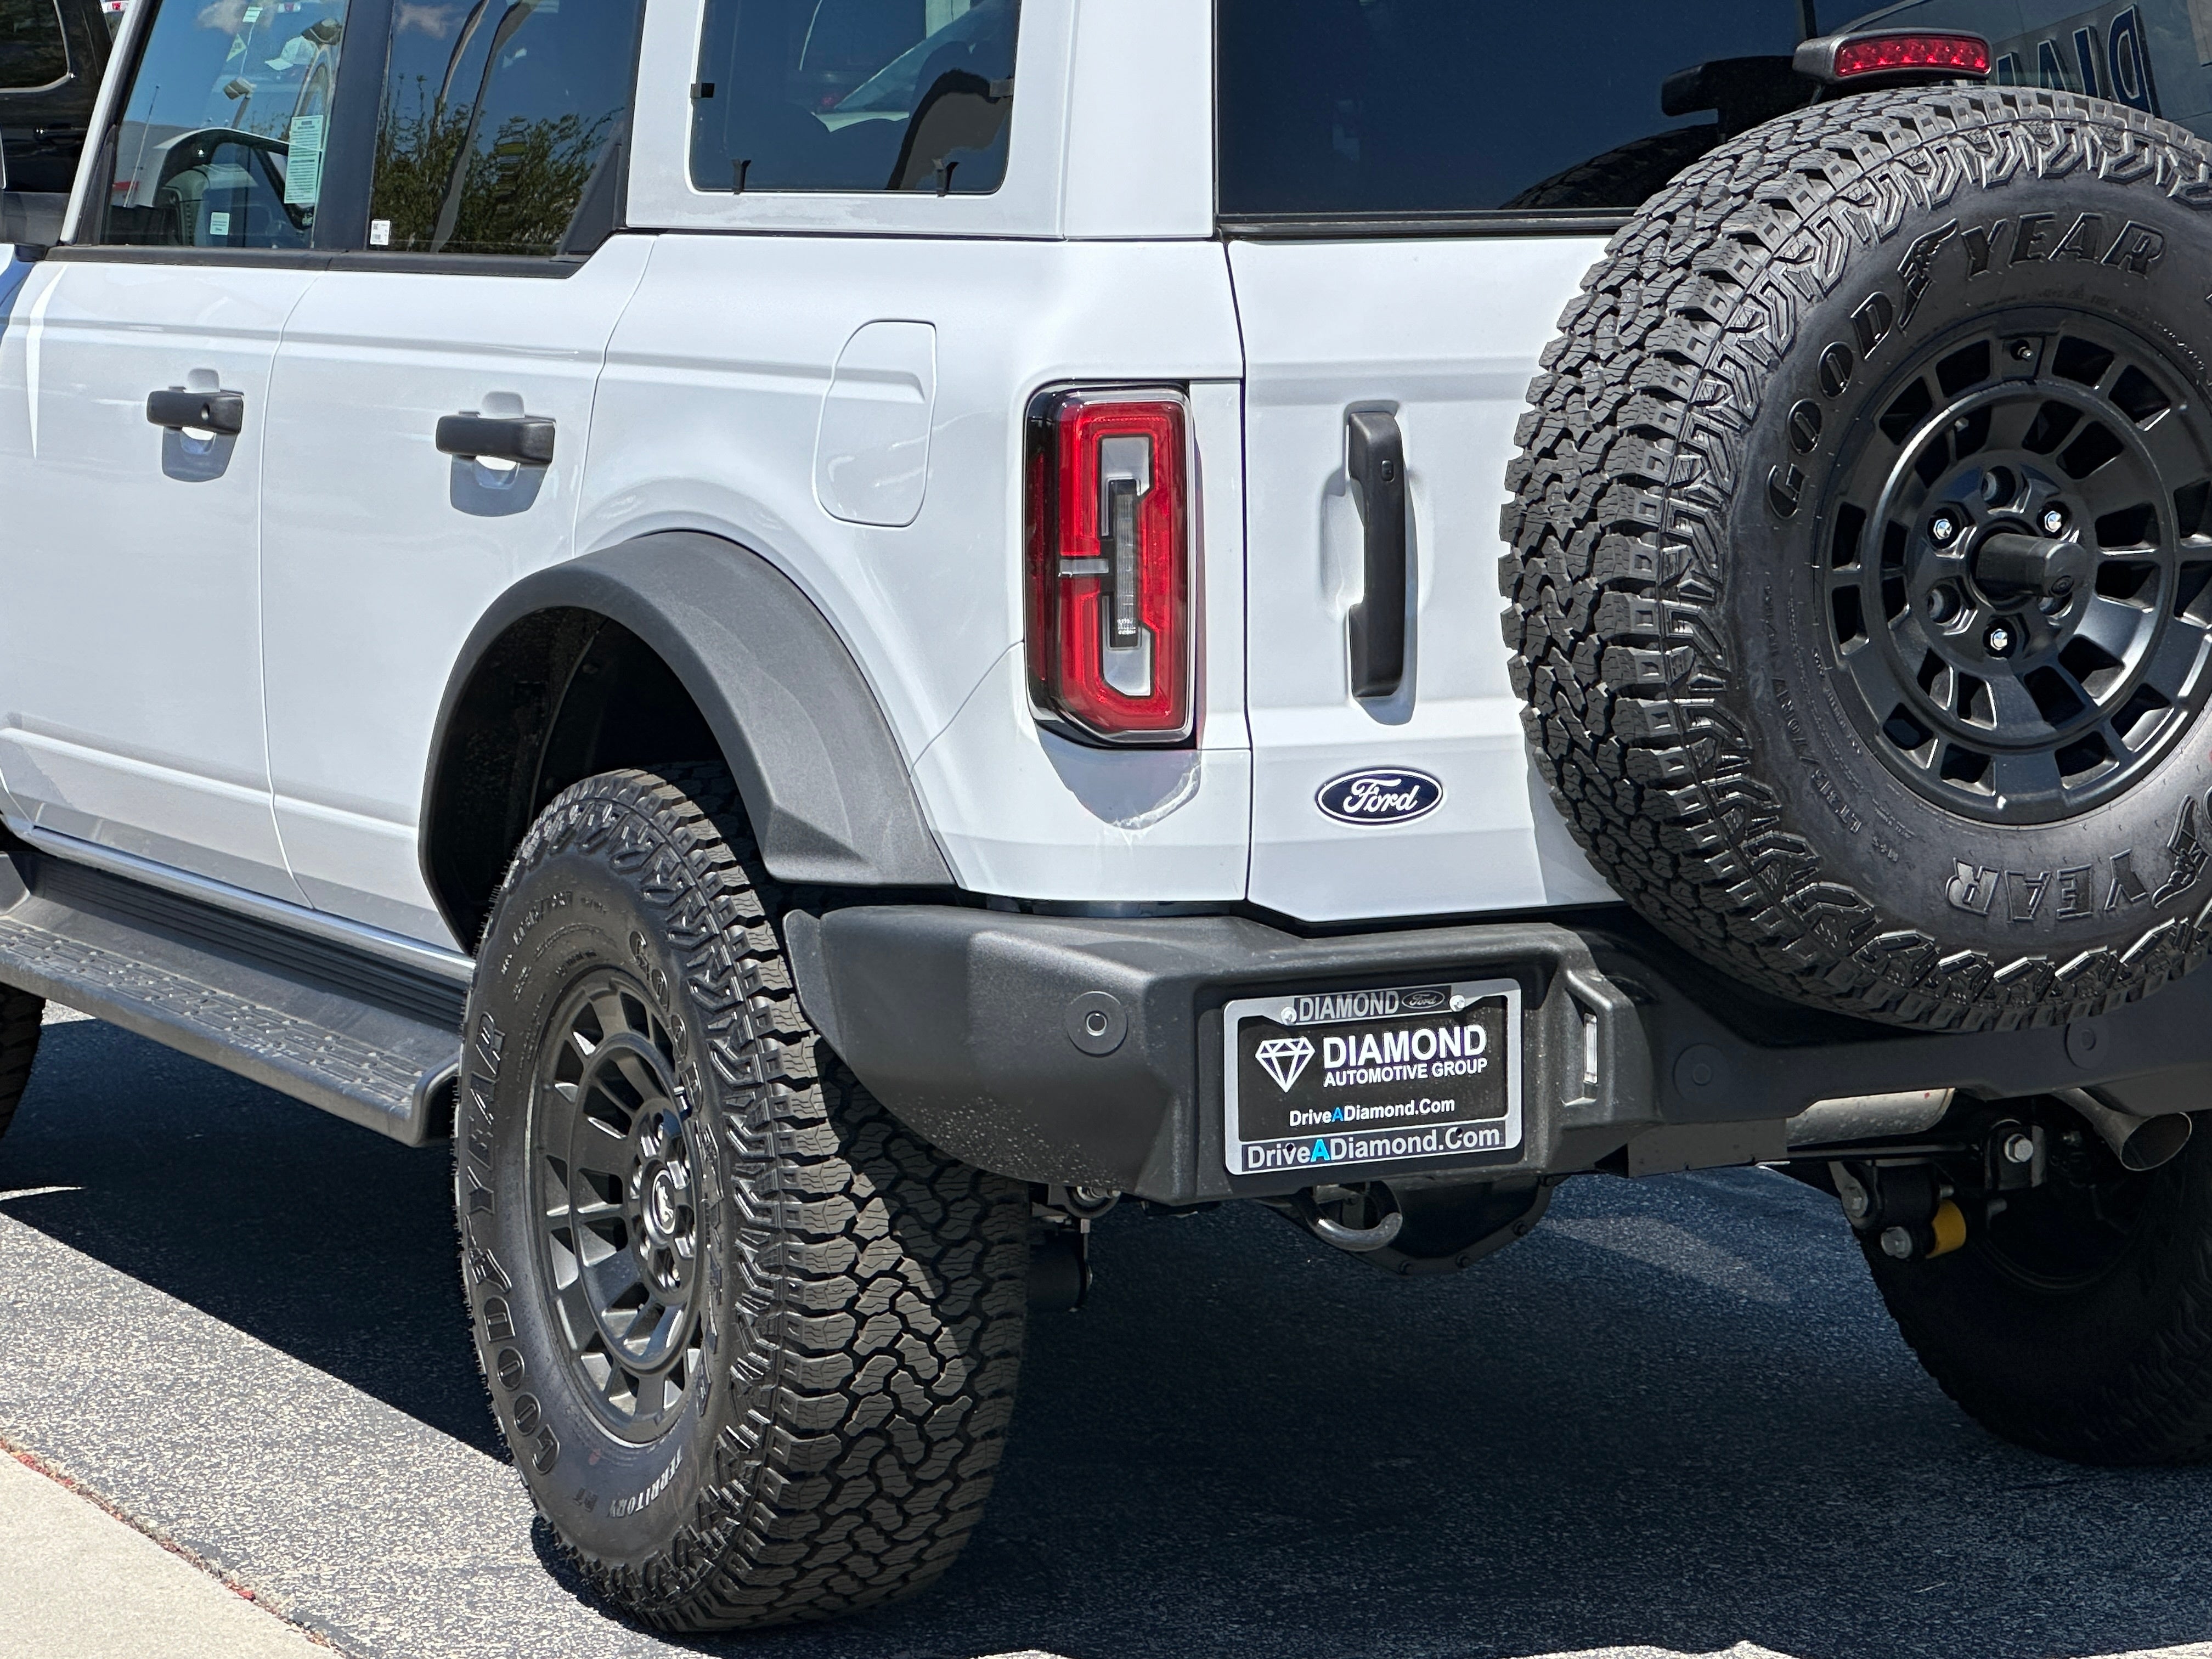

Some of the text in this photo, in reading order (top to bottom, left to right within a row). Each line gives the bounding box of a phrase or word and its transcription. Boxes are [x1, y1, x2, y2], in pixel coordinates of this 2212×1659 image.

[1343, 778, 1420, 813] Ford
[1299, 990, 1437, 1022] DIAMOND Ford
[1323, 1024, 1487, 1069] DIAMOND
[1323, 1058, 1488, 1087] AUTOMOTIVE GROUP
[1289, 1098, 1455, 1126] DriveADiamond.Com
[1247, 1126, 1500, 1169] DriveADiamond.Com
[606, 1445, 682, 1518] TERRITORY
